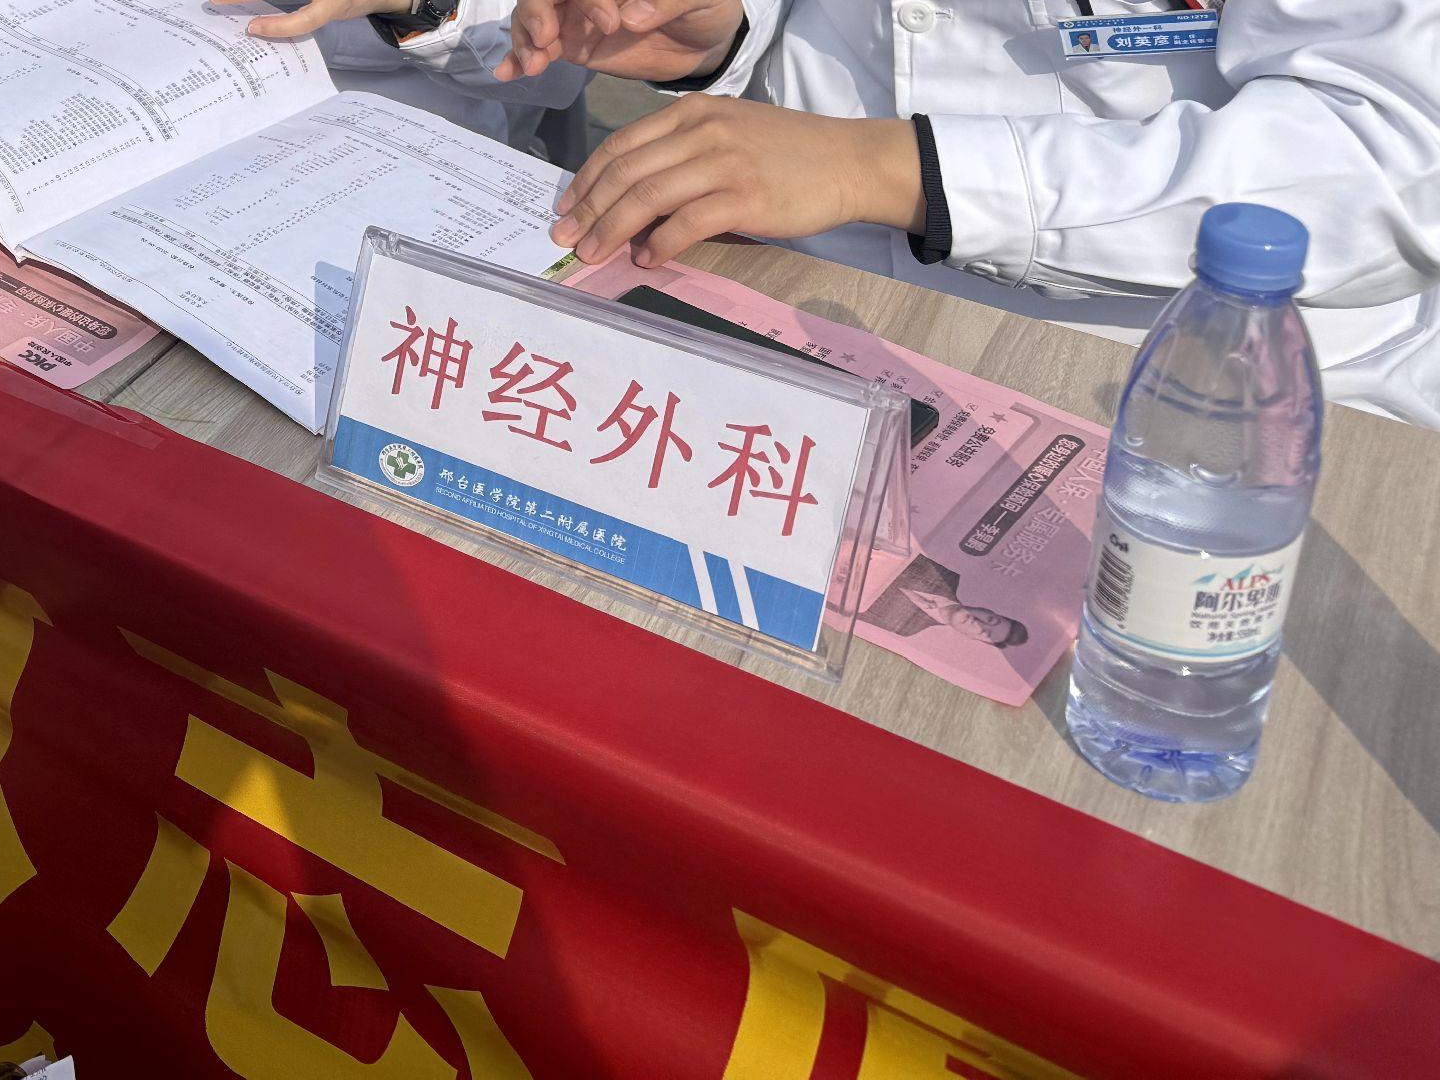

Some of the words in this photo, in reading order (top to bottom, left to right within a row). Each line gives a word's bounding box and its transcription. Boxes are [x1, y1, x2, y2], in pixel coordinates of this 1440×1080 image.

[1116, 35, 1170, 48] 刘英彦
[17, 348, 58, 372] PICC
[380, 304, 820, 537] 神经外科
[945, 423, 996, 470] 免费公益服务
[435, 487, 462, 503] SECOND
[462, 495, 497, 515] AFFILIATED
[496, 509, 527, 528] HOSPITAL
[528, 522, 538, 531] OF
[537, 525, 564, 542] XINGTAI
[564, 535, 594, 555] MEDICAL
[593, 546, 626, 565] COLLEGE
[438, 468, 627, 552] 邢台医学院第二附属医院
[1193, 580, 1281, 612] 阿尔卑斯
[1220, 573, 1272, 591] ALPS
